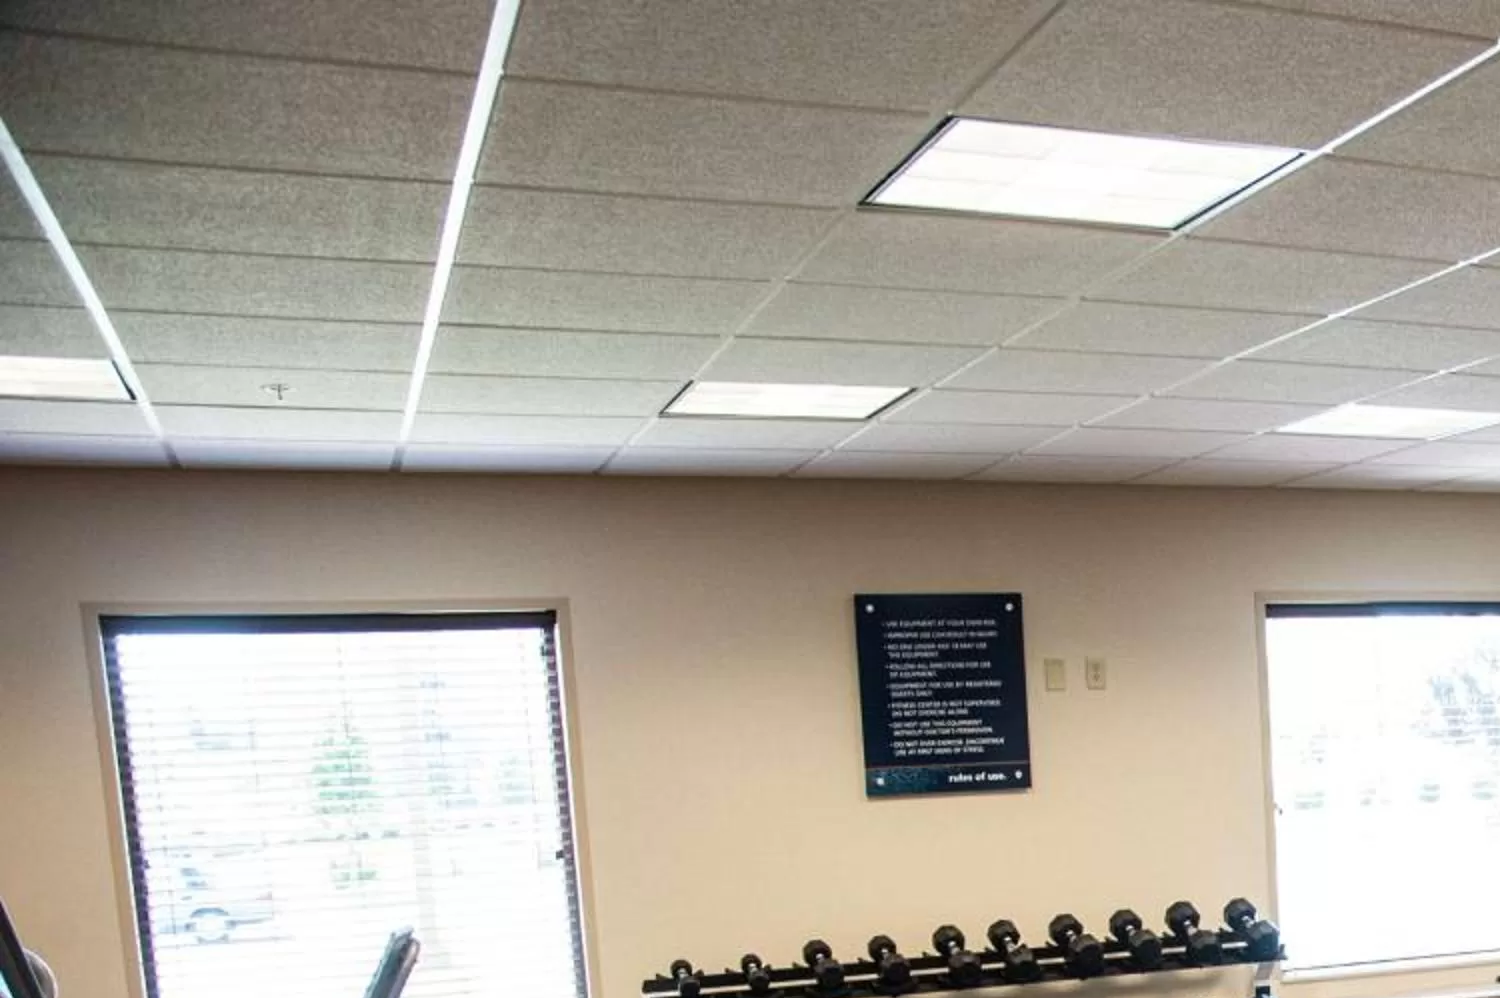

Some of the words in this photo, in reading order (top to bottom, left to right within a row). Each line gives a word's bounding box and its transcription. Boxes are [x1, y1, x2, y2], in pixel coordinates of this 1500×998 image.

[949, 771, 973, 783] rules
[975, 771, 987, 781] of
[988, 772, 1007, 782] use.
